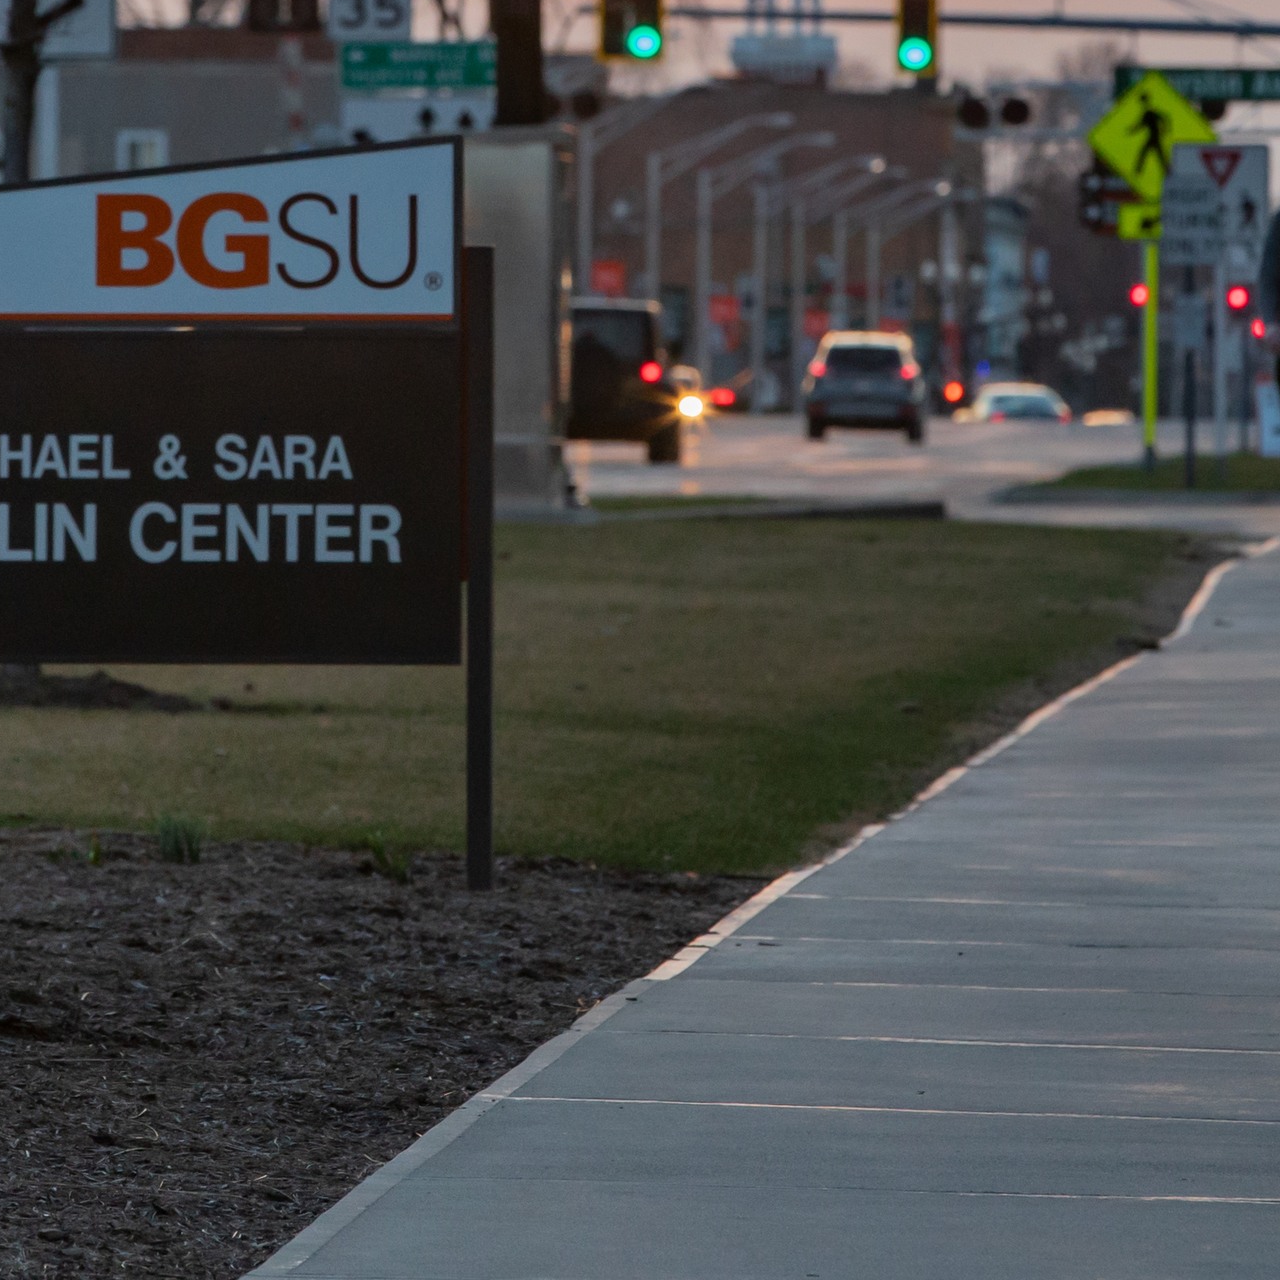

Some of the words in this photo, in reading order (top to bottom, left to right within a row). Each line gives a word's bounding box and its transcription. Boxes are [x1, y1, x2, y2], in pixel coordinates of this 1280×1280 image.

[153, 433, 189, 480] &
[214, 433, 354, 480] SARA
[129, 501, 403, 563] CENTER
